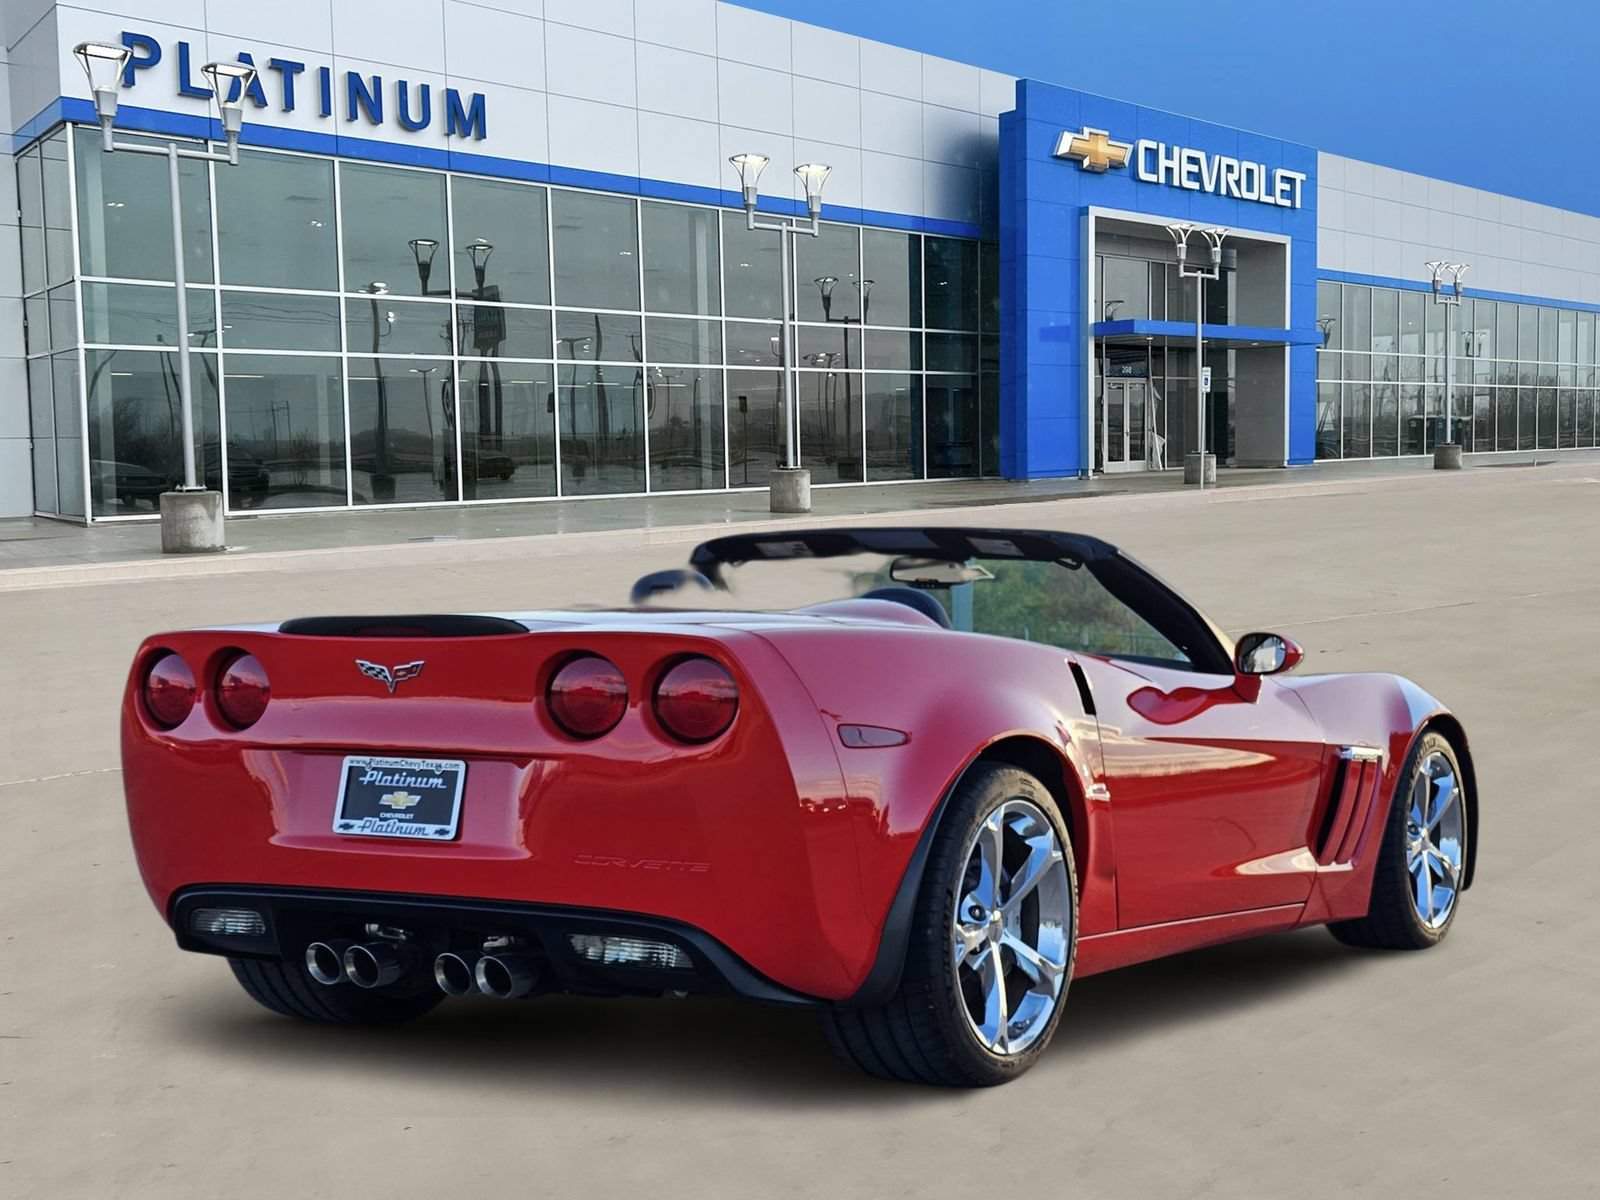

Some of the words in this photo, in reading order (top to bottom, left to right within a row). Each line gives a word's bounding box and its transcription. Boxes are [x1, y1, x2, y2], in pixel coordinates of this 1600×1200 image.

[120, 31, 487, 141] PLATINUM
[1135, 138, 1306, 208] CHEVROLET
[359, 770, 447, 789] Platinum
[357, 819, 430, 836] Platinum
[573, 854, 711, 873] CORVETTE
